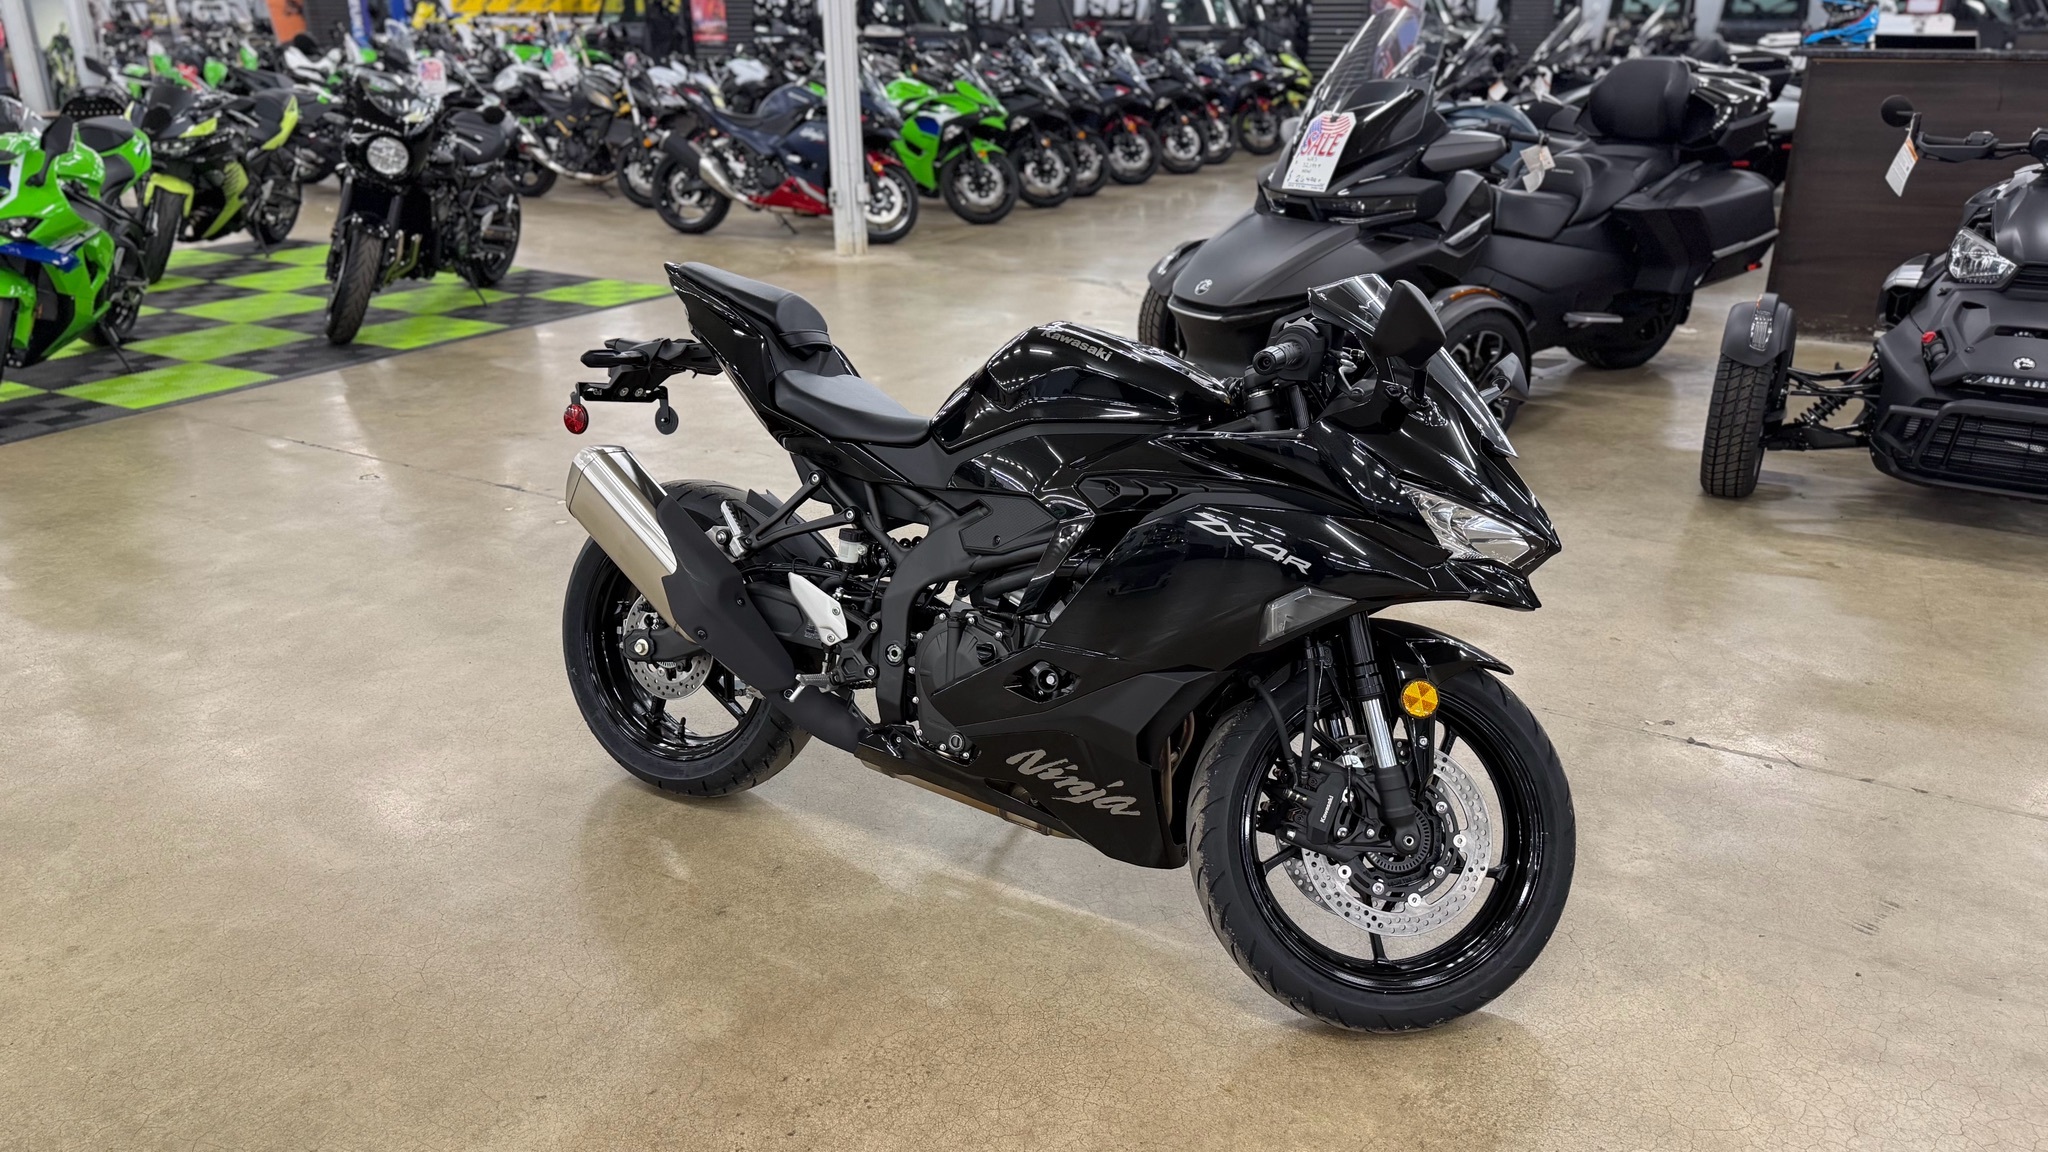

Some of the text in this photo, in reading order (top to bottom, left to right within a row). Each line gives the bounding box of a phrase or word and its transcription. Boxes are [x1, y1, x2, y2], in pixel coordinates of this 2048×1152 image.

[1301, 132, 1344, 157] SALE
[1040, 329, 1113, 362] Kawasaki
[1186, 511, 1312, 575] ZX-4R
[1005, 749, 1141, 816] Ninja
